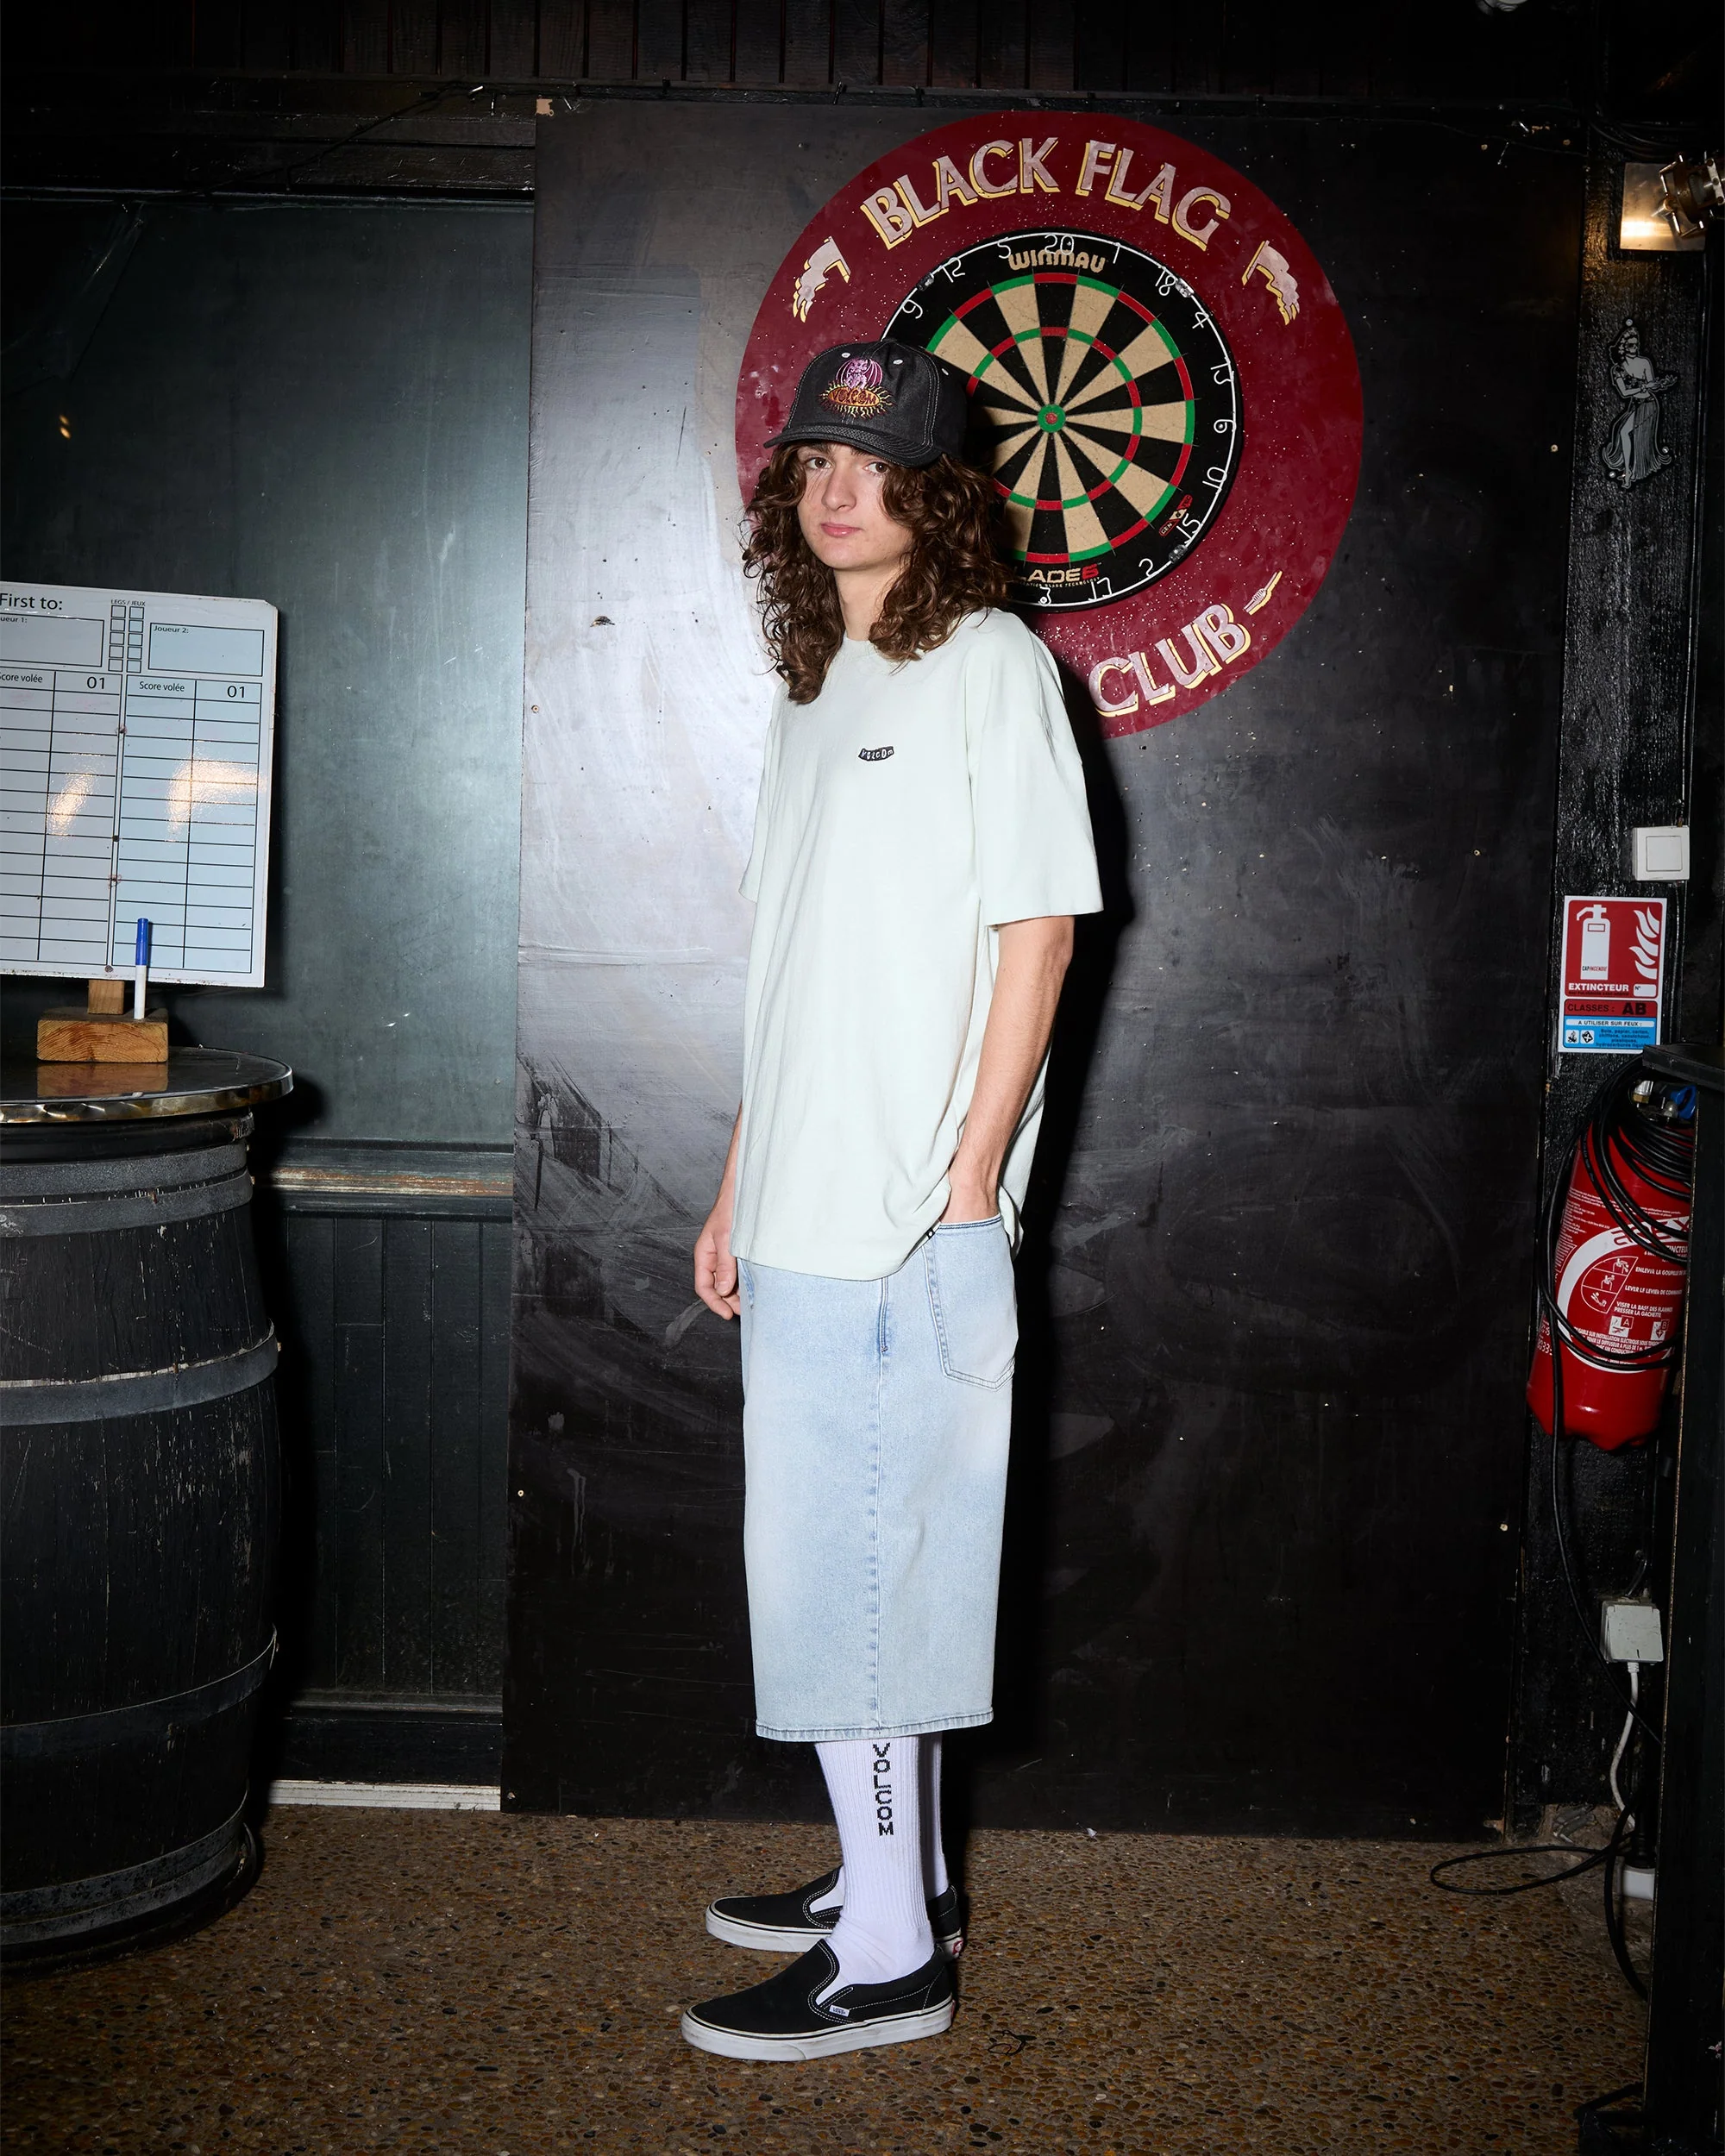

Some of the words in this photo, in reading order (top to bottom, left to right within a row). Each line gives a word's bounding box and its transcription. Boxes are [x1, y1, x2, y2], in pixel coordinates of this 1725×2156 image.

[860, 137, 1060, 250] BLACK
[1076, 139, 1233, 252] FLAG
[997, 237, 1012, 259] 5
[1044, 233, 1075, 256] 20
[939, 256, 966, 283] 12
[1008, 248, 1106, 273] WINMAU
[1155, 266, 1176, 296] 18
[1192, 311, 1209, 329] 4
[1202, 467, 1227, 494] 10
[1176, 513, 1202, 544] 15
[1138, 558, 1160, 580] 2
[1038, 586, 1052, 607] 3
[1088, 577, 1113, 602] 17
[0, 592, 35, 609] First
[40, 597, 63, 611] to:
[154, 625, 179, 634] Joueur
[1088, 604, 1252, 718] CLUB
[21, 674, 43, 683] volée
[139, 680, 161, 692] Score
[163, 682, 185, 693] volée
[1568, 982, 1629, 992] EXTINCTEUR
[1567, 1003, 1609, 1012] CLASSES
[1622, 1001, 1647, 1016] AB
[1622, 1318, 1630, 1326] A
[872, 1742, 894, 1837] VOLCOM
